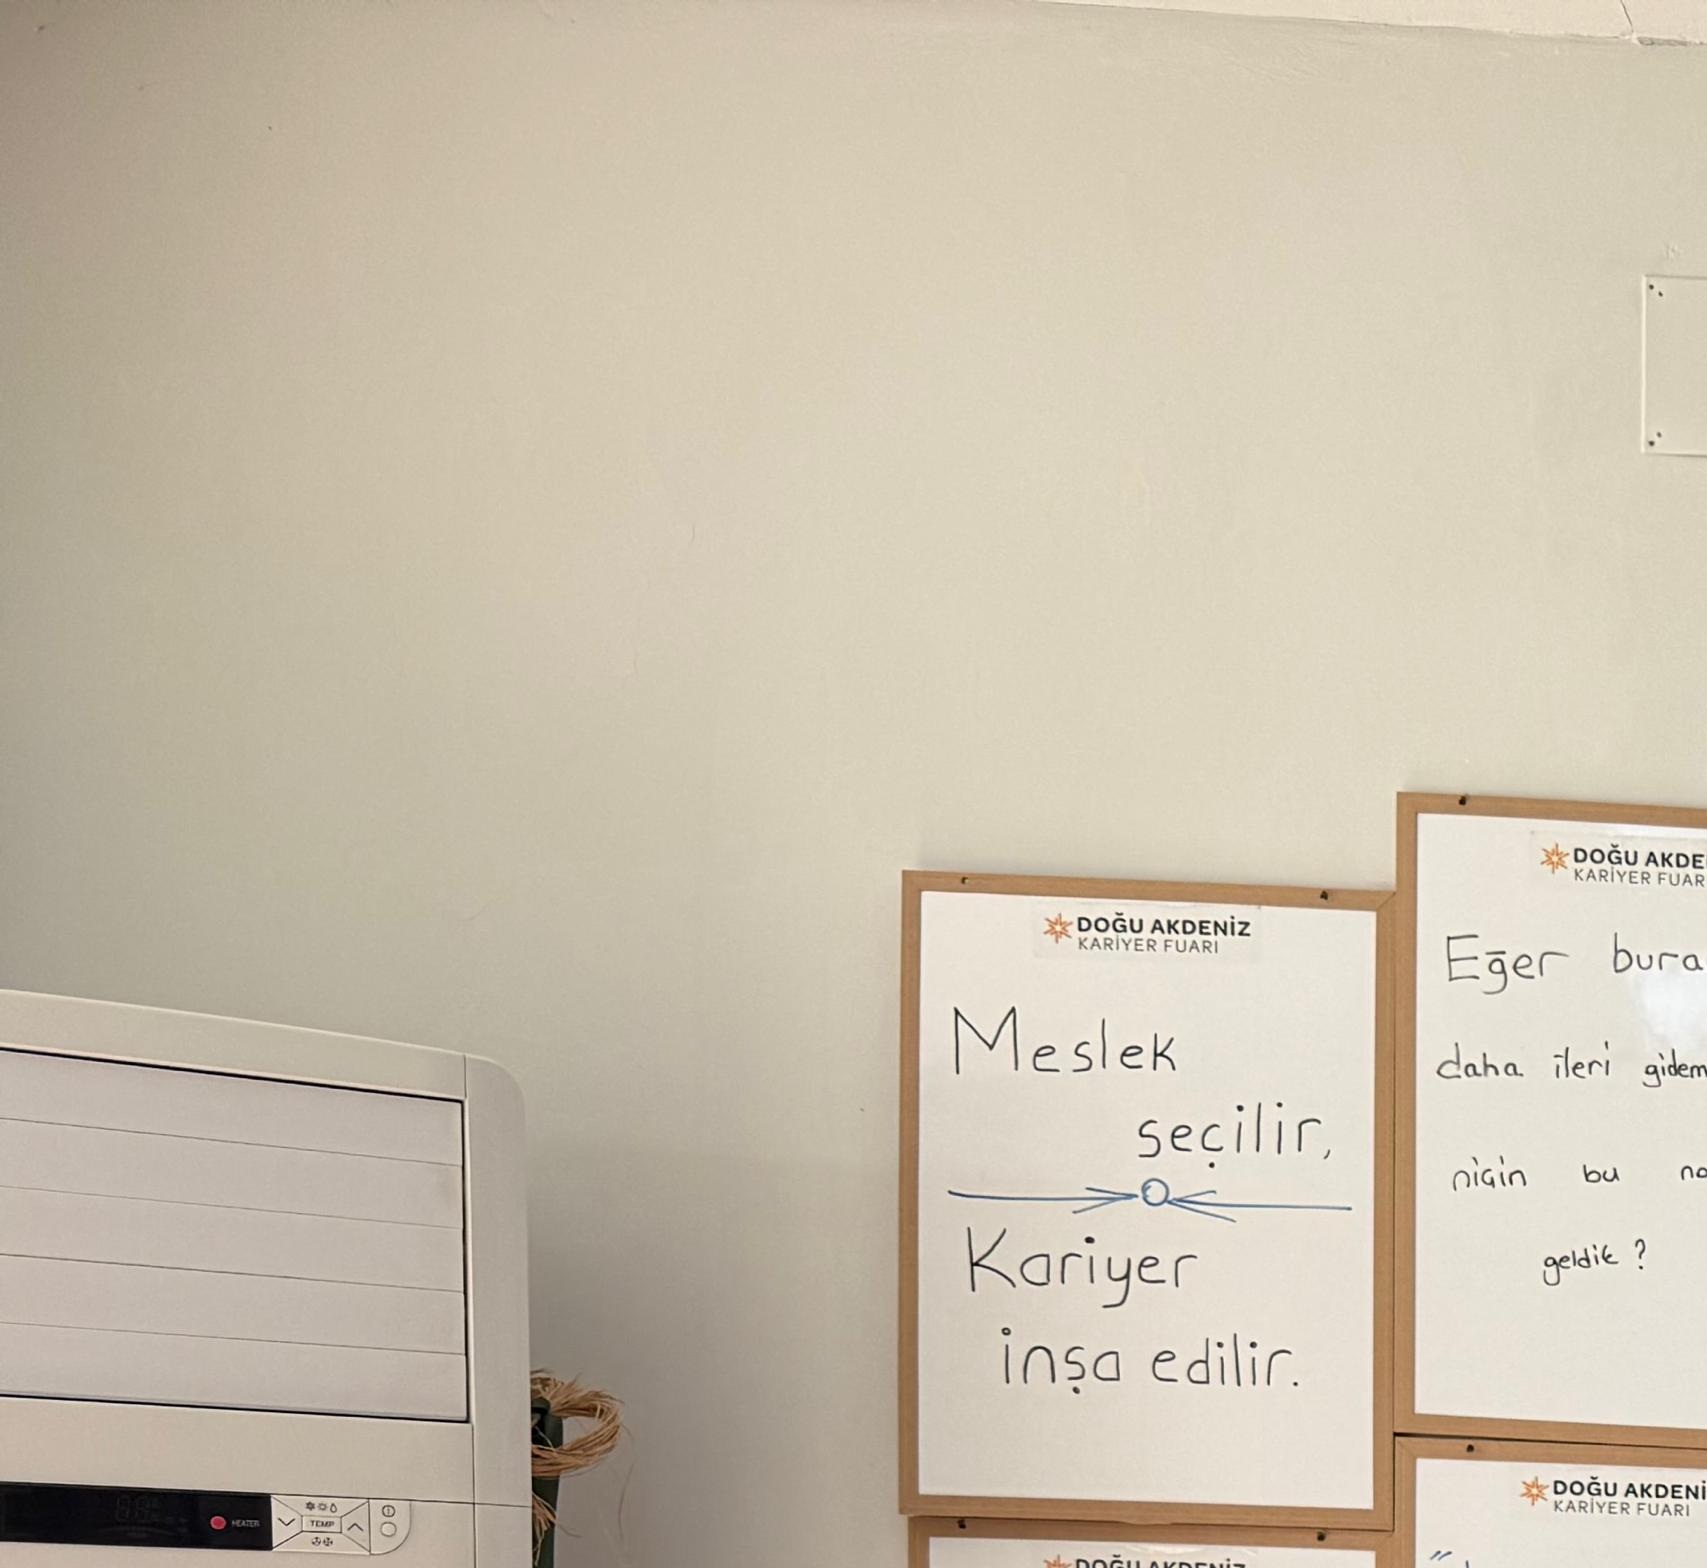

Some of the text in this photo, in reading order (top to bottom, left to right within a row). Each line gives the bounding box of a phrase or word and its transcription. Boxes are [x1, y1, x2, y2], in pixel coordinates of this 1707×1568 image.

[1076, 911, 1252, 938] DOĞU AKDENİZ
[1077, 934, 1219, 955] KARİYER FUARI
[1445, 933, 1570, 996] Eğer
[952, 1005, 1177, 1076] Meslek
[1435, 1041, 1525, 1080] daha
[1552, 1039, 1610, 1080] ileri
[1137, 1101, 1331, 1169] seçilir,
[1582, 1163, 1621, 1184] bu
[966, 1225, 1199, 1310] Kariyer
[1000, 1326, 1299, 1395] inşa edilir.
[310, 1520, 335, 1528] TEMP
